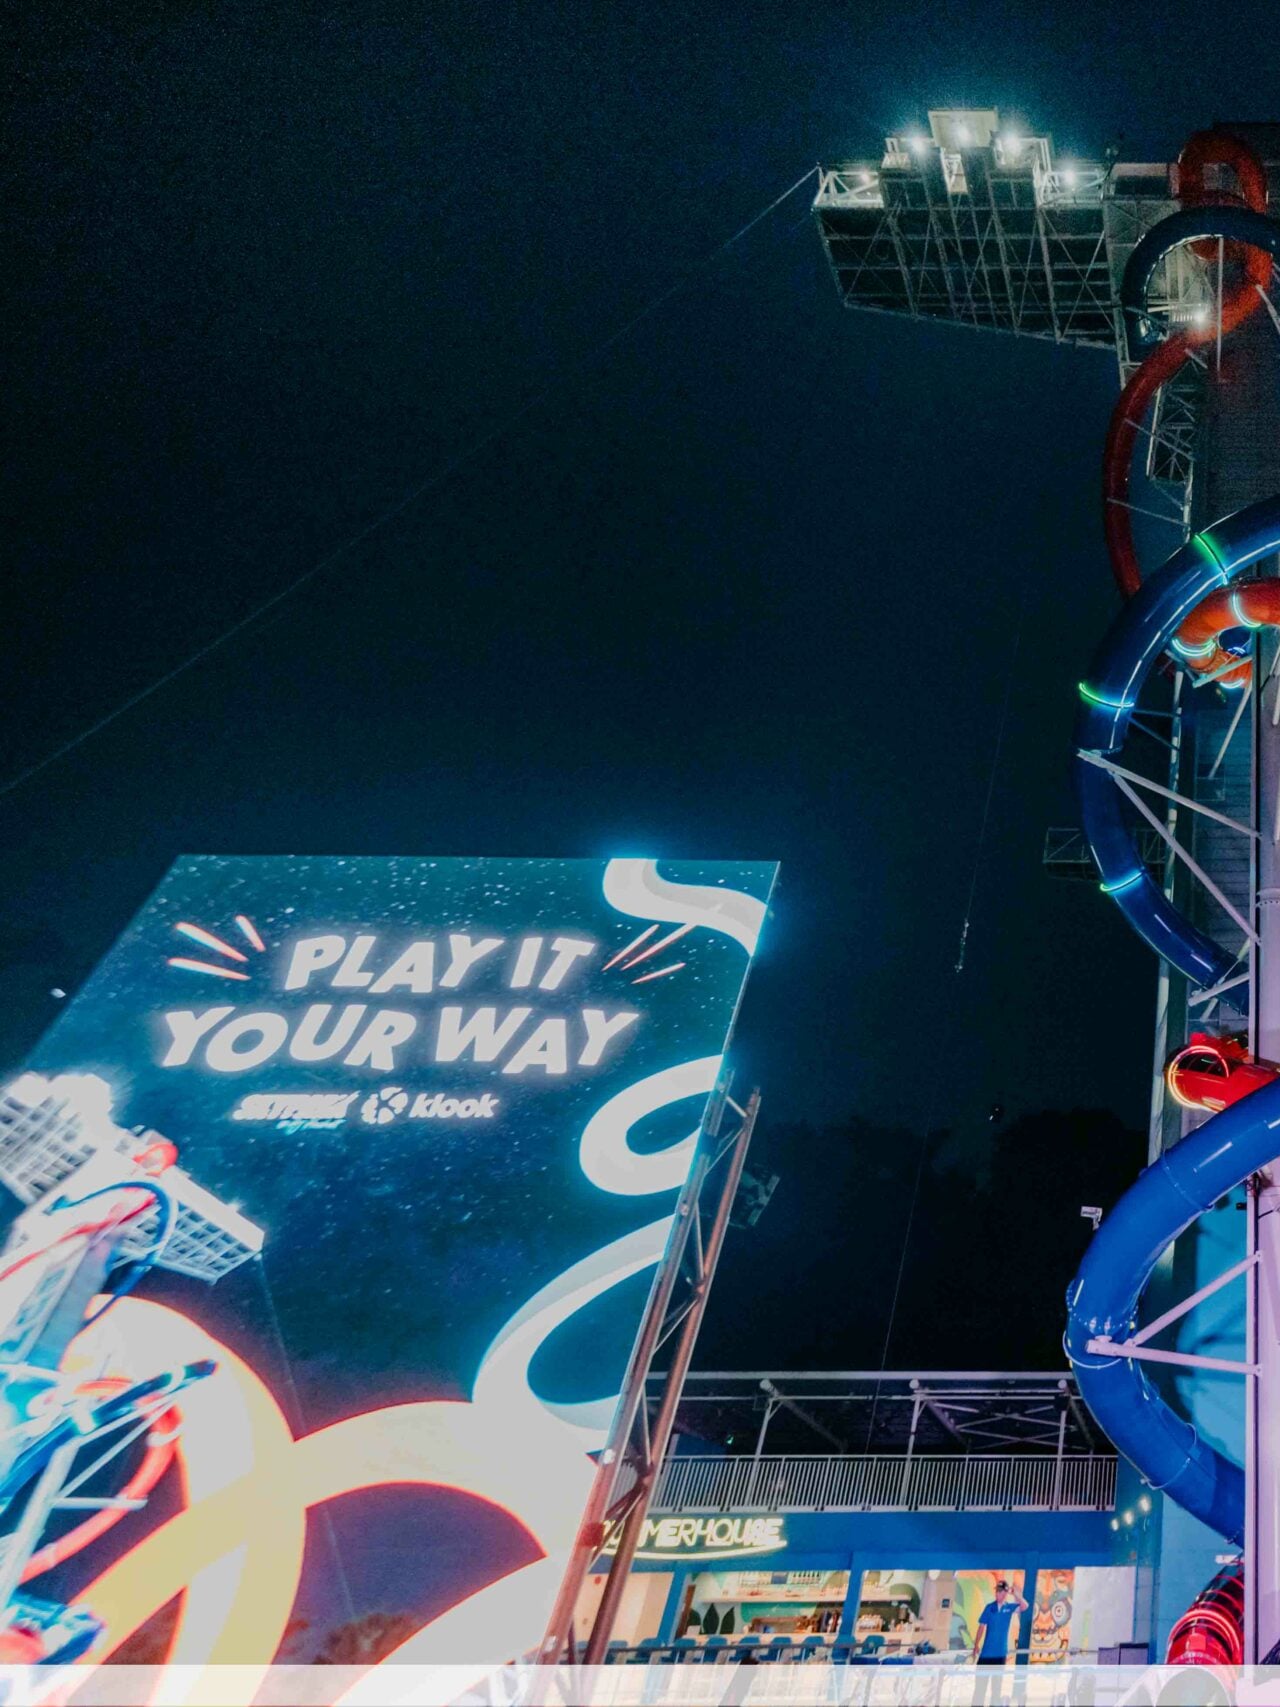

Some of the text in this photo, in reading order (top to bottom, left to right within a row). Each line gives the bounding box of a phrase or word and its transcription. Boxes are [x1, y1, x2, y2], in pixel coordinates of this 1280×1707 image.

[285, 935, 595, 993] PLAY IT
[162, 1004, 639, 1075] YOUR WAY
[409, 1093, 499, 1118] klook
